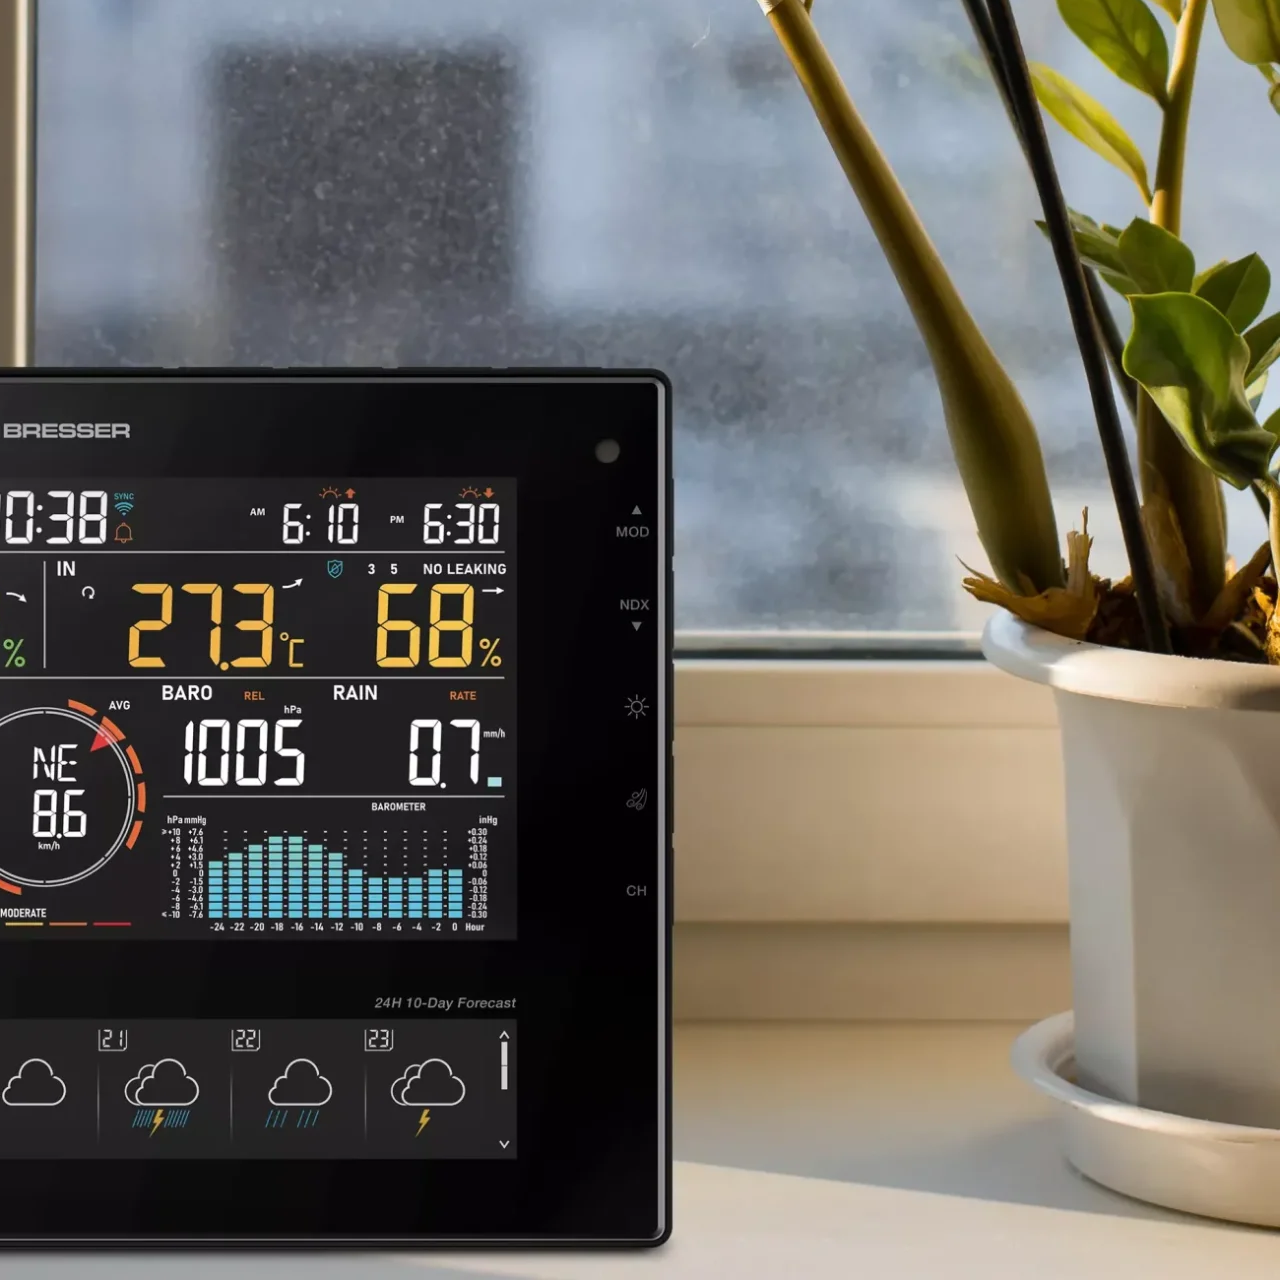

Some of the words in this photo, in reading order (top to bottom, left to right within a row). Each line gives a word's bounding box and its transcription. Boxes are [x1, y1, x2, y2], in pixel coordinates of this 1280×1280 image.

[3, 422, 131, 439] BRESSER
[113, 492, 135, 501] SYNC
[249, 507, 266, 516] AM
[282, 503, 360, 545] 6:10
[389, 515, 405, 524] PM
[422, 503, 500, 545] 6:30
[616, 525, 650, 538] MOD
[57, 560, 76, 577] IN
[367, 563, 376, 575] 3
[390, 563, 398, 575] 5
[423, 563, 443, 575] NO
[447, 563, 507, 575] LEAKING
[619, 598, 650, 611] NDX
[375, 583, 475, 668] 68
[161, 684, 213, 701] BARO
[243, 690, 265, 701] REL
[333, 684, 378, 701] RAIN
[449, 690, 477, 701] RATE
[108, 700, 131, 711] AVG
[283, 704, 302, 714] hPa
[183, 718, 305, 787] 1005
[408, 718, 481, 789] 0.7
[483, 727, 506, 739] mm/h
[32, 743, 78, 782] NE
[371, 802, 426, 812] BAROMETER
[32, 789, 87, 840] 8.6
[166, 814, 184, 824] hPa
[183, 815, 207, 827] mmHg
[478, 815, 498, 827] inHg
[188, 828, 204, 836] +7.6
[37, 840, 61, 852] km/h
[189, 837, 204, 845] +6.1
[187, 845, 204, 853] +4.6
[188, 853, 204, 861] +3.0
[189, 861, 204, 869] +1.5
[172, 869, 178, 877] 0
[198, 869, 204, 877] 0
[171, 878, 181, 886] -2
[189, 878, 204, 886] -1.5
[170, 886, 181, 894] -4
[187, 886, 204, 894] -3.0
[626, 885, 647, 896] CH
[171, 894, 181, 902] -6
[187, 894, 204, 902] -4.6
[0, 907, 47, 918] MODERATE
[171, 903, 181, 911] -8
[189, 903, 204, 911] -6.1
[188, 911, 204, 919] -7.6
[209, 922, 225, 932] -24
[229, 922, 245, 932] -22
[249, 922, 265, 932] -20
[270, 922, 284, 932] -18
[290, 922, 304, 932] -16
[310, 922, 324, 932] -14
[330, 922, 344, 932] -12
[350, 922, 364, 932] -10
[372, 922, 382, 932] -8
[392, 922, 402, 932] -6
[411, 922, 423, 931] -4
[431, 922, 442, 932] -2
[451, 922, 458, 932] 0
[465, 922, 485, 932] Hour
[374, 997, 403, 1009] 24H
[406, 996, 454, 1012] 10-Day
[457, 996, 517, 1009] Forecast
[102, 1029, 123, 1048] 21
[235, 1029, 257, 1048] 22
[368, 1029, 389, 1048] 23
